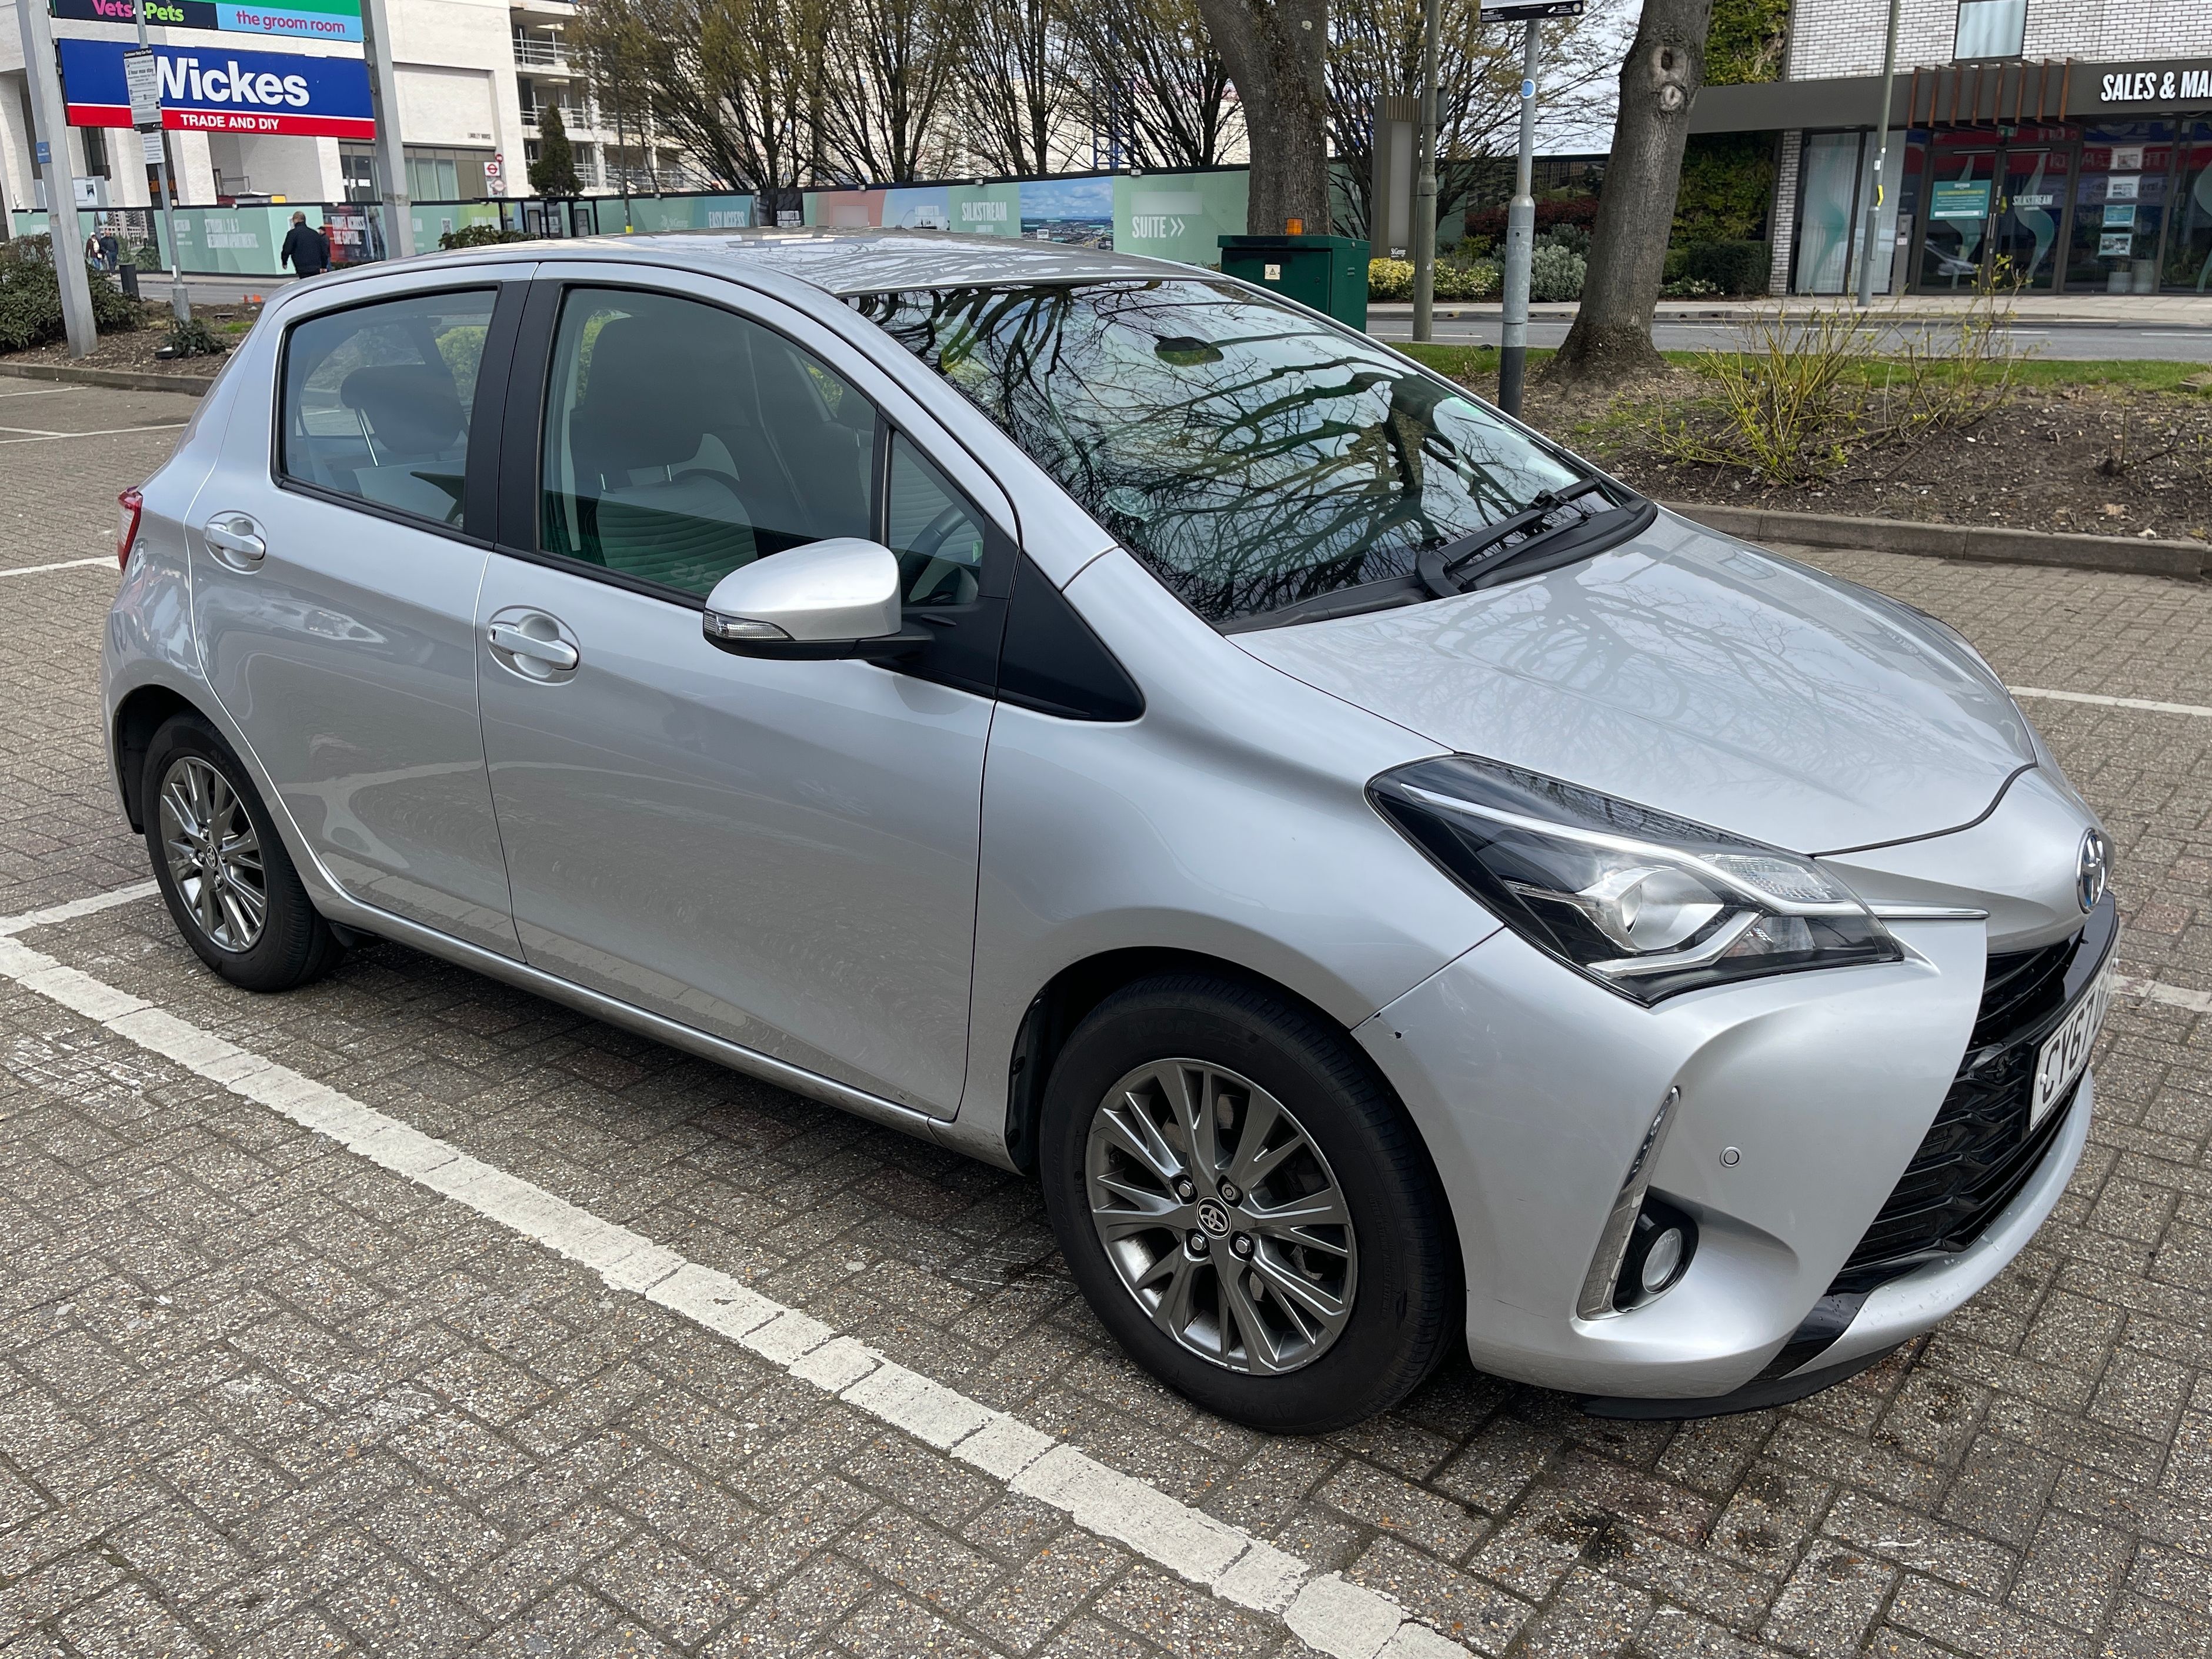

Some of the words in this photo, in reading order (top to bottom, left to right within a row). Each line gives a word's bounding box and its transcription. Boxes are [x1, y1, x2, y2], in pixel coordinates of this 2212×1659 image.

[236, 10, 259, 26] the
[263, 14, 307, 31] groom
[310, 18, 346, 34] room
[2100, 72, 2157, 102] SALES
[2159, 71, 2176, 100] &
[2180, 70, 2212, 98] MA
[180, 114, 226, 128] TRADE
[229, 116, 256, 129] AND
[259, 118, 279, 131] DIY
[708, 211, 723, 228] EASY
[723, 211, 745, 228] ACCESS
[962, 202, 1007, 221] SILKSTREAM
[1132, 216, 1166, 238] SUITE
